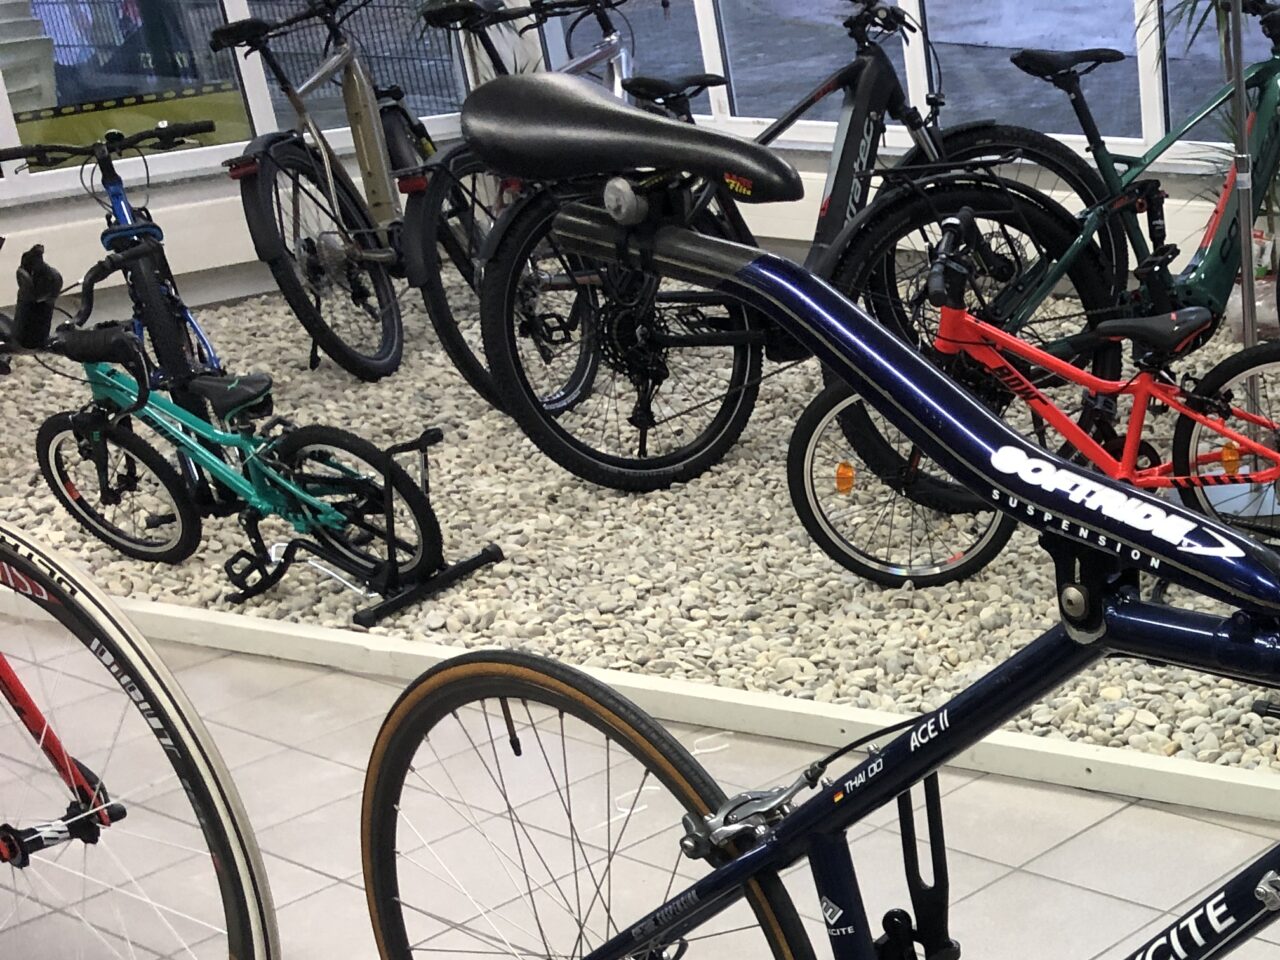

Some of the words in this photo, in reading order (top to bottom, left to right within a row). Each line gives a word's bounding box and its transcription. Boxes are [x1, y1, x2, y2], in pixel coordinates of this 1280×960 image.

[990, 487, 1161, 569] SUSPENSION
[909, 717, 938, 751] ACE
[939, 709, 950, 731] II
[844, 770, 866, 794] THAI
